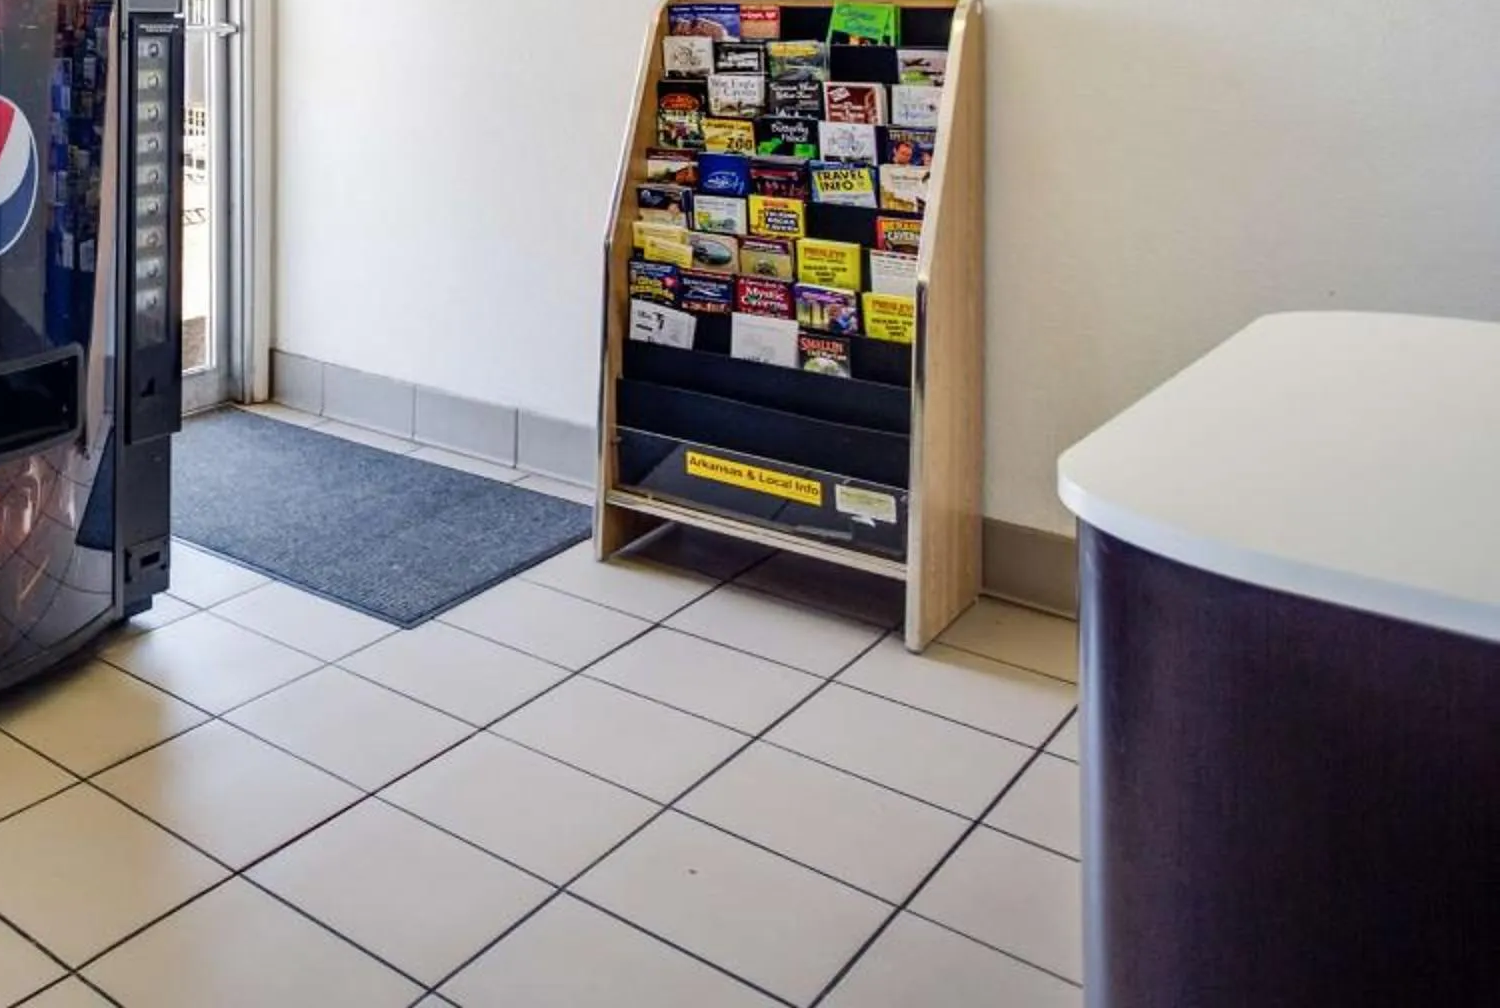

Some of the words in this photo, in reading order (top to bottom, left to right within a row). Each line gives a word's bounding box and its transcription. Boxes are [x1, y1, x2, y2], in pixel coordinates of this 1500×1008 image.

[817, 170, 865, 180] TRAVEL
[819, 179, 855, 191] INFO
[688, 455, 743, 479] Arkansas
[746, 469, 757, 481] &
[759, 471, 793, 490] Local
[795, 478, 819, 496] Info
